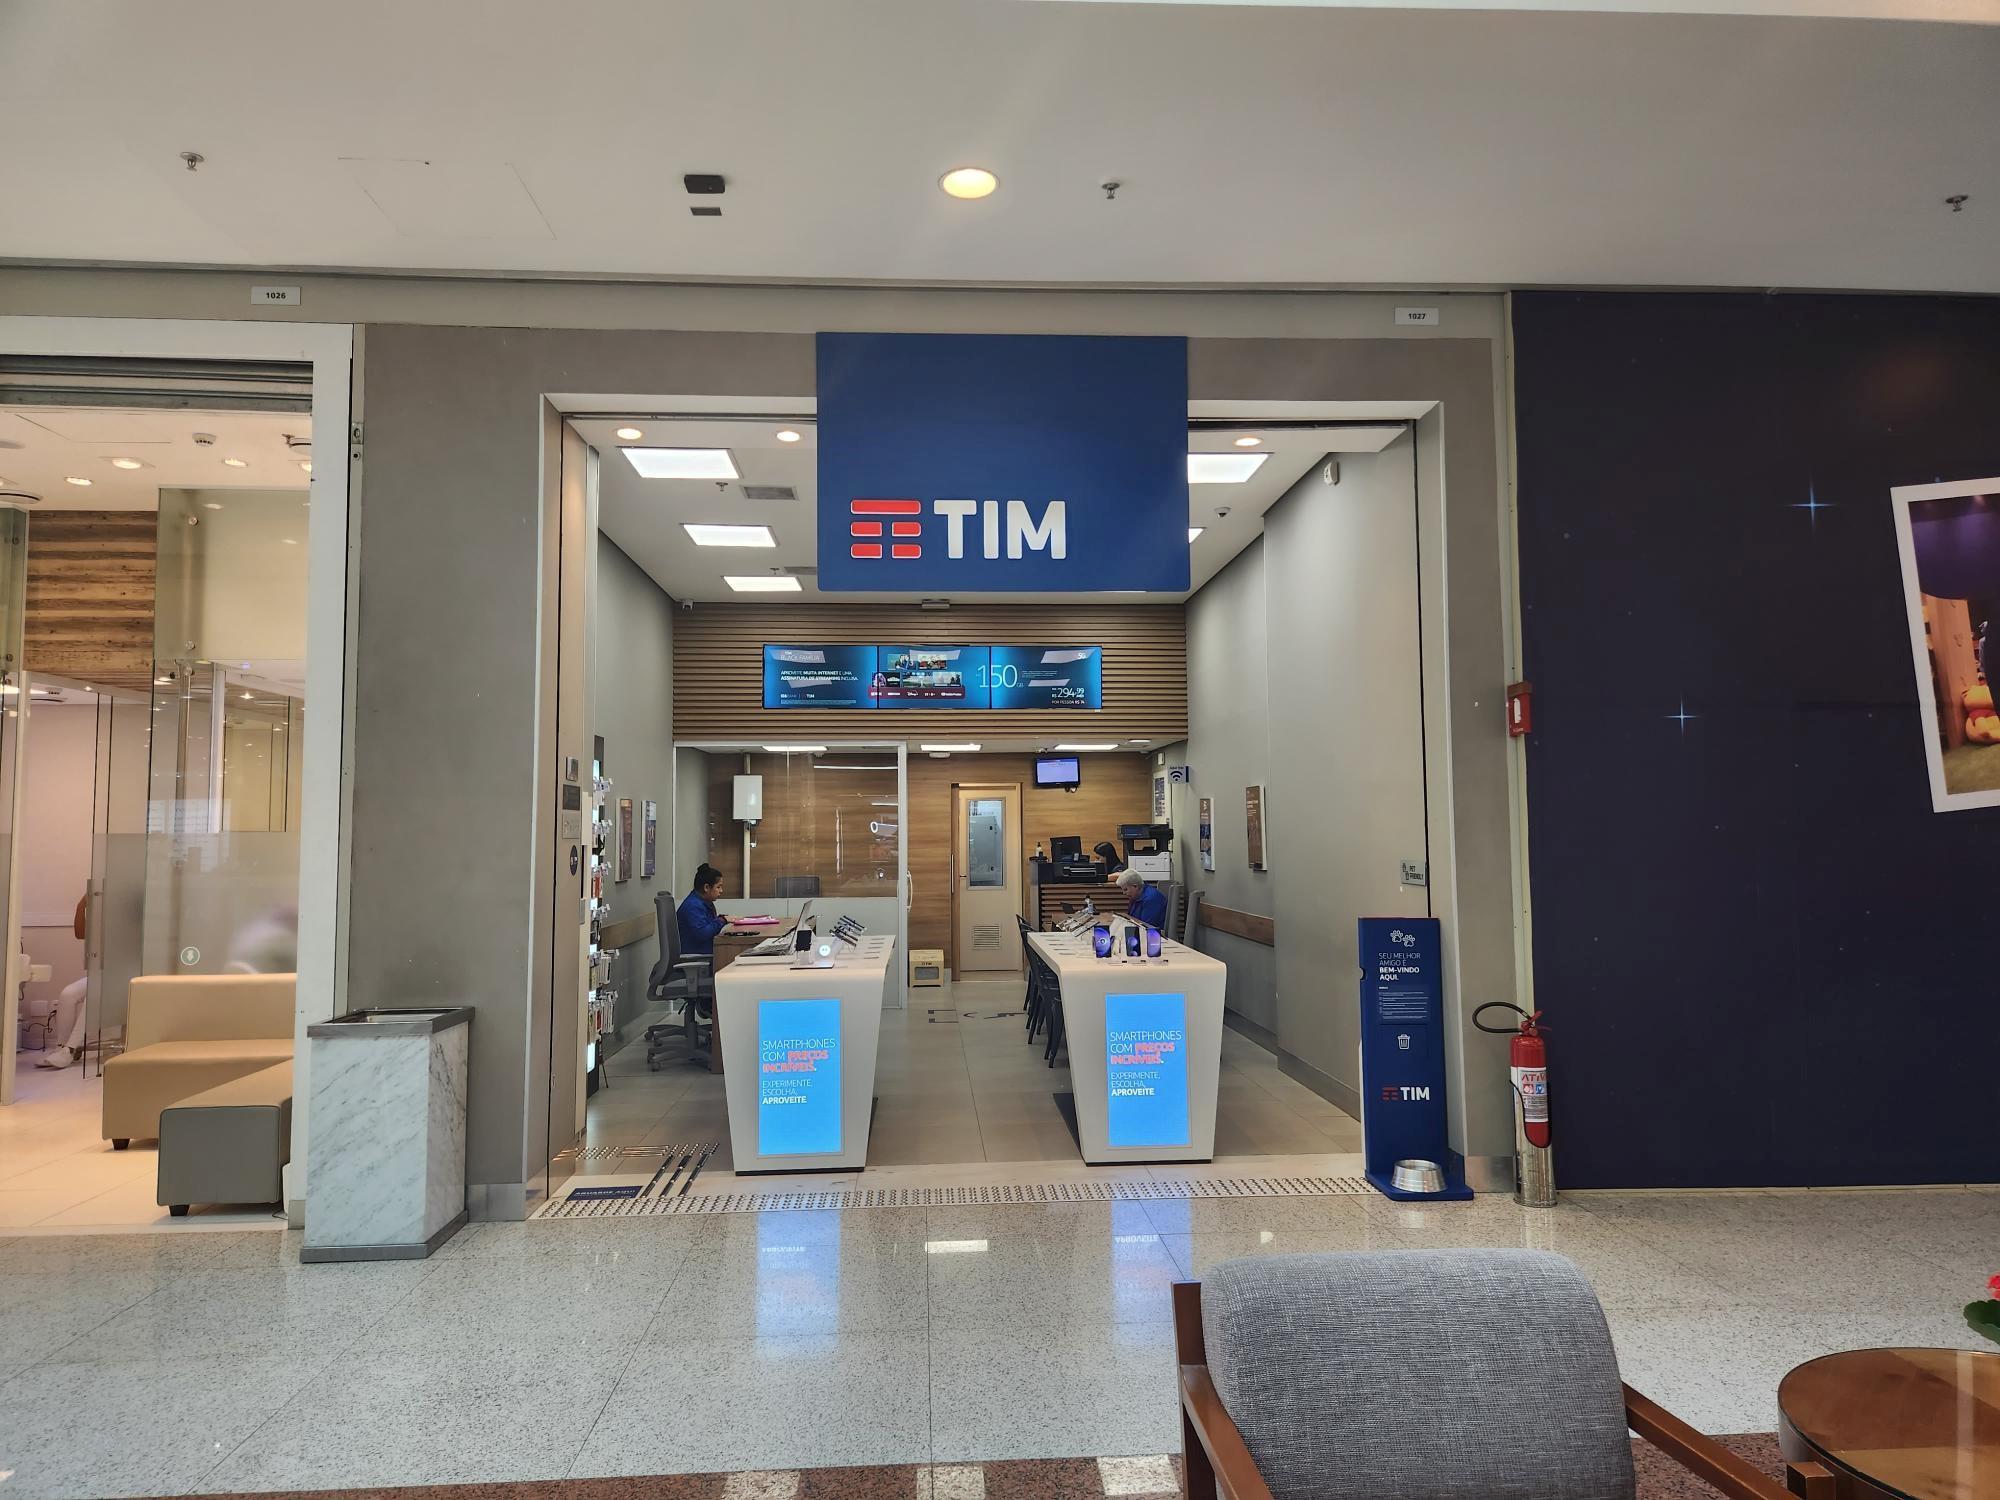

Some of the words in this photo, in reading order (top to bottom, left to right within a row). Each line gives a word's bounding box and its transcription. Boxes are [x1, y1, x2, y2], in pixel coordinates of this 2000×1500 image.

[933, 499, 1067, 560] TIM
[977, 664, 1018, 688] 150
[1378, 952, 1392, 960] SEU
[1393, 952, 1421, 960] MELHOR
[1379, 966, 1420, 974] BEM-VINDO
[1110, 1031, 1181, 1041] SMARTPHONES
[763, 1039, 836, 1050] SMARTPHONES
[1110, 1043, 1133, 1054] COM
[762, 1051, 785, 1062] COM
[1111, 1088, 1155, 1096] APROVEITE
[1400, 1086, 1430, 1101] TIM
